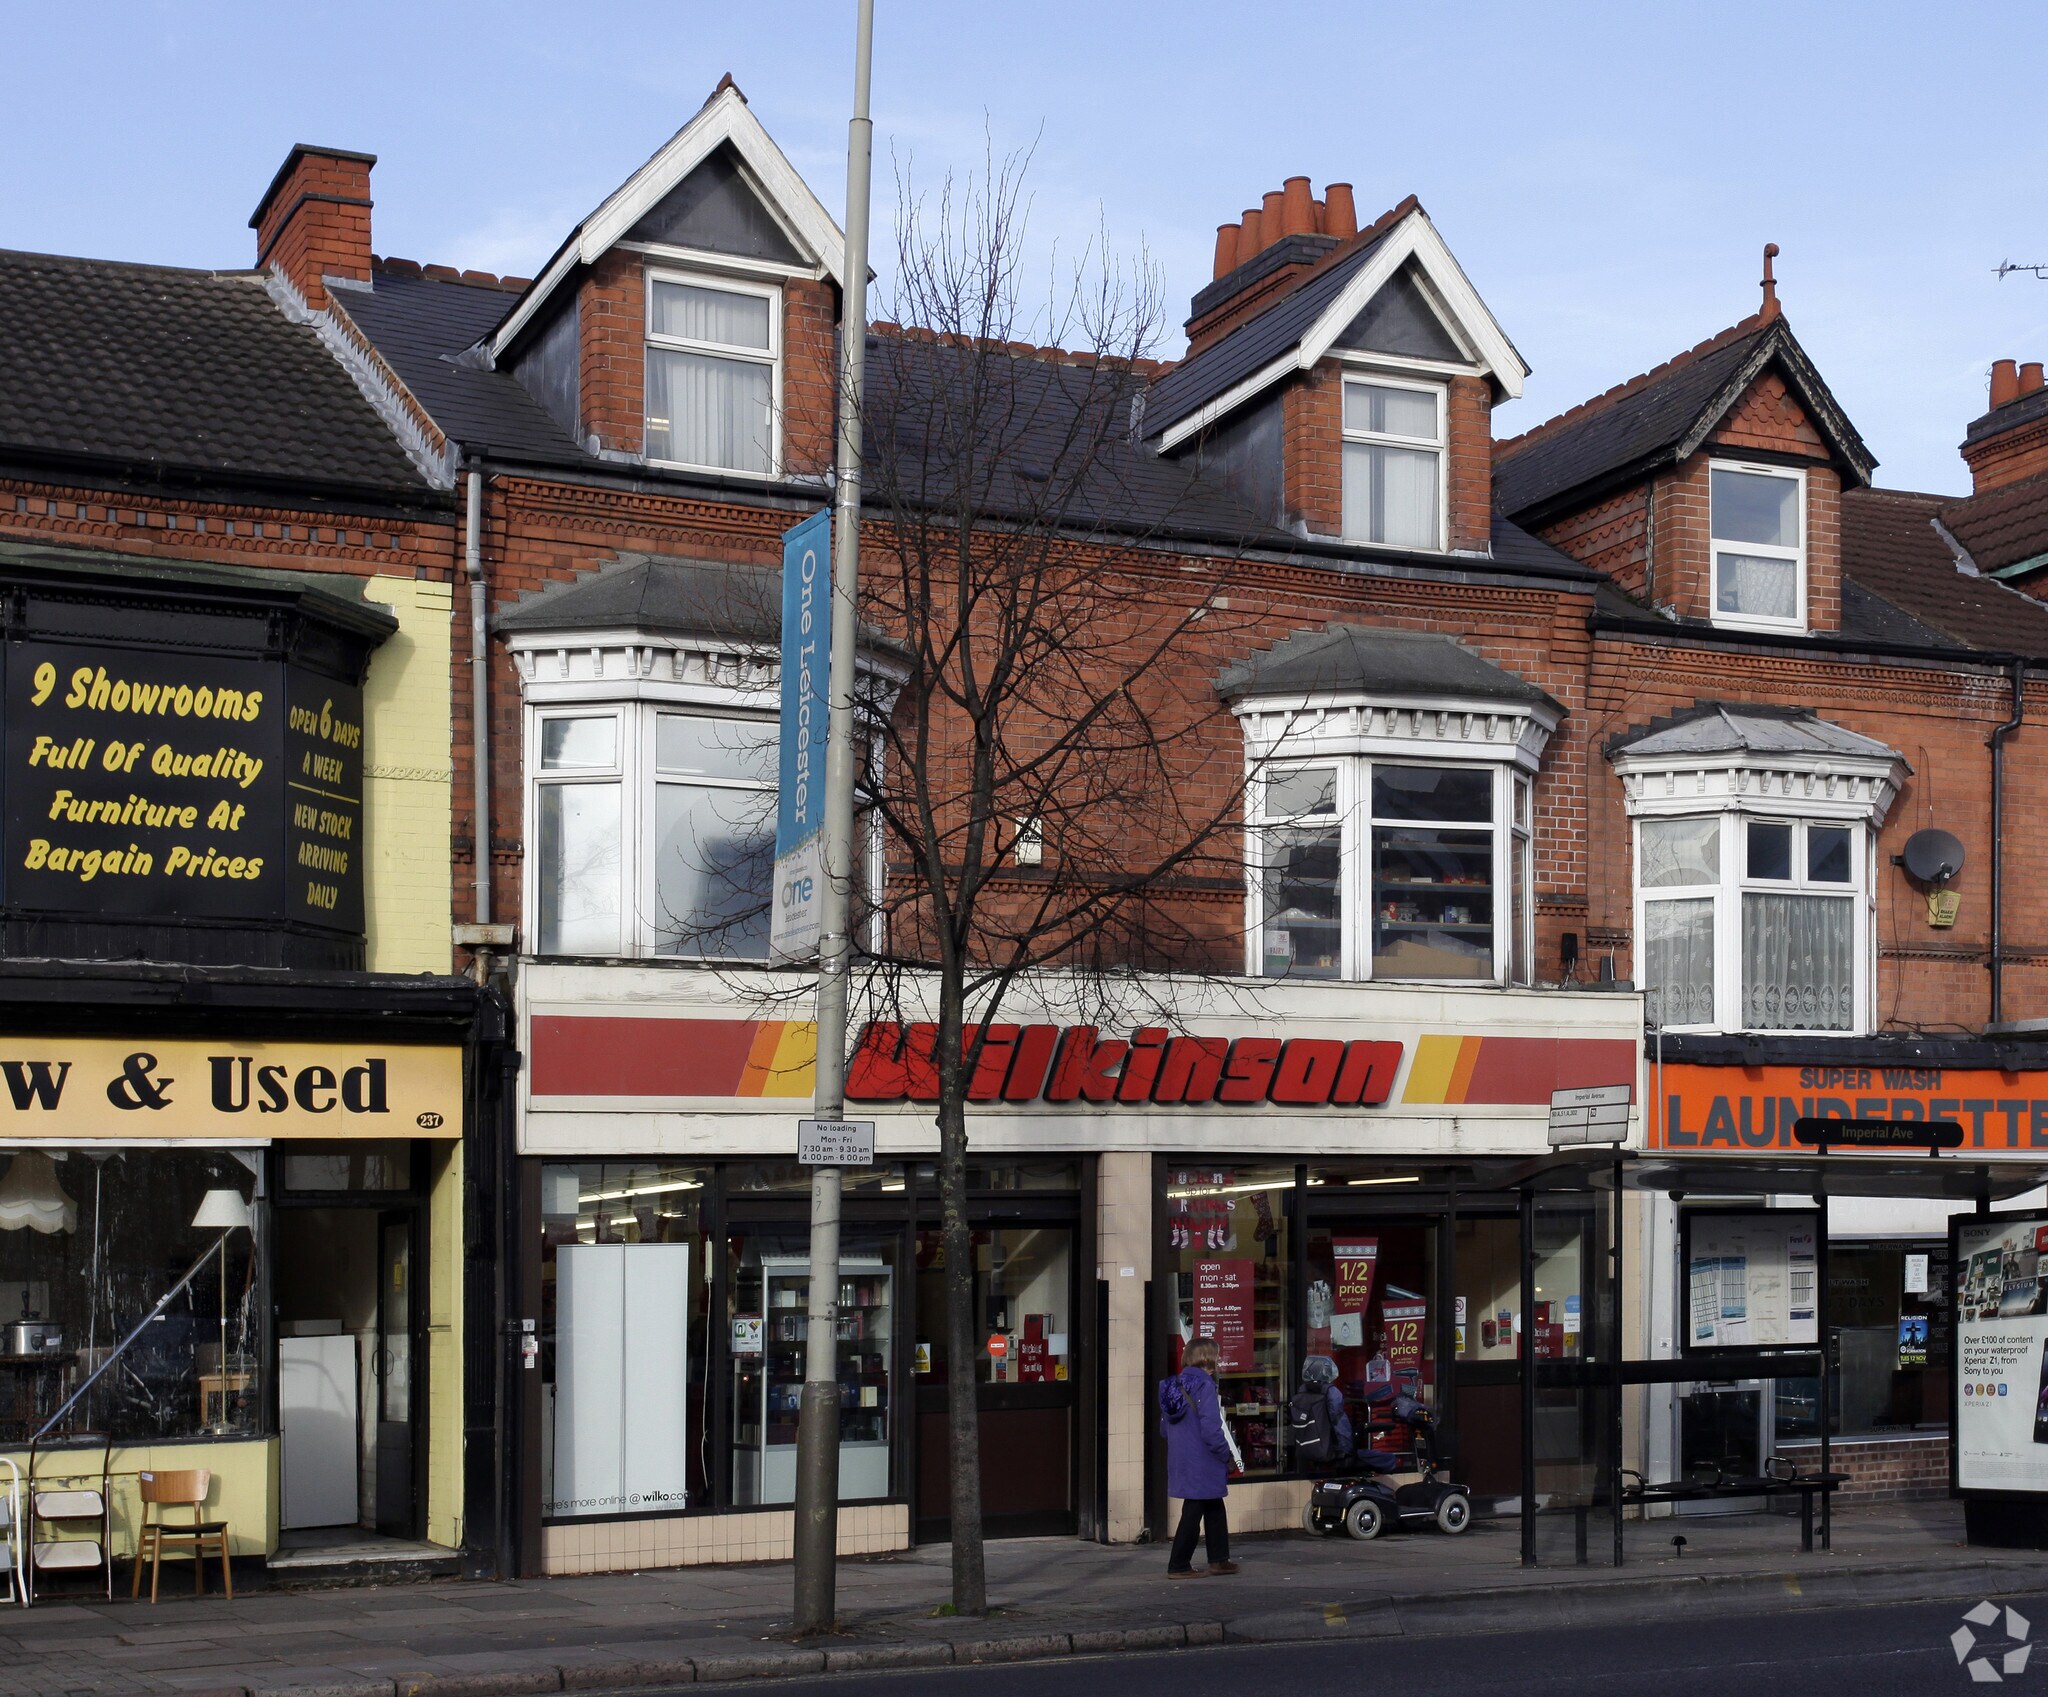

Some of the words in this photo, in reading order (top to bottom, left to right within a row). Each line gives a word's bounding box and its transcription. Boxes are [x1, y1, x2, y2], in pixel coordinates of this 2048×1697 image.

[801, 549, 816, 635] One
[31, 662, 57, 707] 9
[65, 666, 263, 722] Showrooms
[290, 704, 318, 734] OPEN
[319, 698, 333, 740] 6
[333, 721, 360, 750] DAYS
[795, 640, 815, 824] Leicester
[29, 736, 95, 770] Full
[103, 740, 145, 773] Of
[151, 743, 263, 789] Quality
[303, 751, 311, 776] A
[313, 754, 342, 785] WEEK
[49, 790, 198, 830] Furniture
[207, 800, 246, 832] At
[294, 803, 318, 833] NEW
[319, 809, 352, 841] STOCK
[24, 839, 153, 882] Bargain
[165, 846, 264, 881] Prices
[298, 840, 348, 875] ARRIVING
[306, 880, 338, 911] DAILY
[781, 875, 813, 909] one
[106, 1053, 174, 1110] &
[208, 1056, 390, 1114] Used
[1799, 1068, 1872, 1090] SUPER
[1881, 1069, 1942, 1091] WASH
[419, 1114, 441, 1128] 237
[816, 1124, 828, 1132] No
[829, 1125, 857, 1133] loading
[1841, 1125, 1890, 1140] Imperial
[1891, 1126, 1914, 1140] Ave
[803, 1145, 821, 1153] 7.30
[1963, 1228, 1991, 1237] SONY
[1200, 1263, 1220, 1273] open
[1224, 1273, 1236, 1281] sat
[1340, 1261, 1368, 1280] 1/2
[1339, 1282, 1367, 1297] price
[2004, 1282, 2035, 1292] ELYSIUM
[1391, 1322, 1418, 1342] 1/2
[1964, 1335, 1980, 1344] Over
[1981, 1335, 1998, 1344] £100
[1998, 1335, 2006, 1344] of
[2006, 1335, 2034, 1344] content
[1390, 1344, 1418, 1359] price
[1963, 1347, 1973, 1355] on
[1974, 1347, 1990, 1356] your
[1990, 1346, 2028, 1357] waterproof
[2000, 1356, 2018, 1365] from
[1963, 1367, 1981, 1377] Sony
[1982, 1367, 1990, 1375] to
[1990, 1368, 2004, 1377] you
[570, 1496, 597, 1508] more
[599, 1495, 627, 1506] online
[629, 1493, 640, 1504] @
